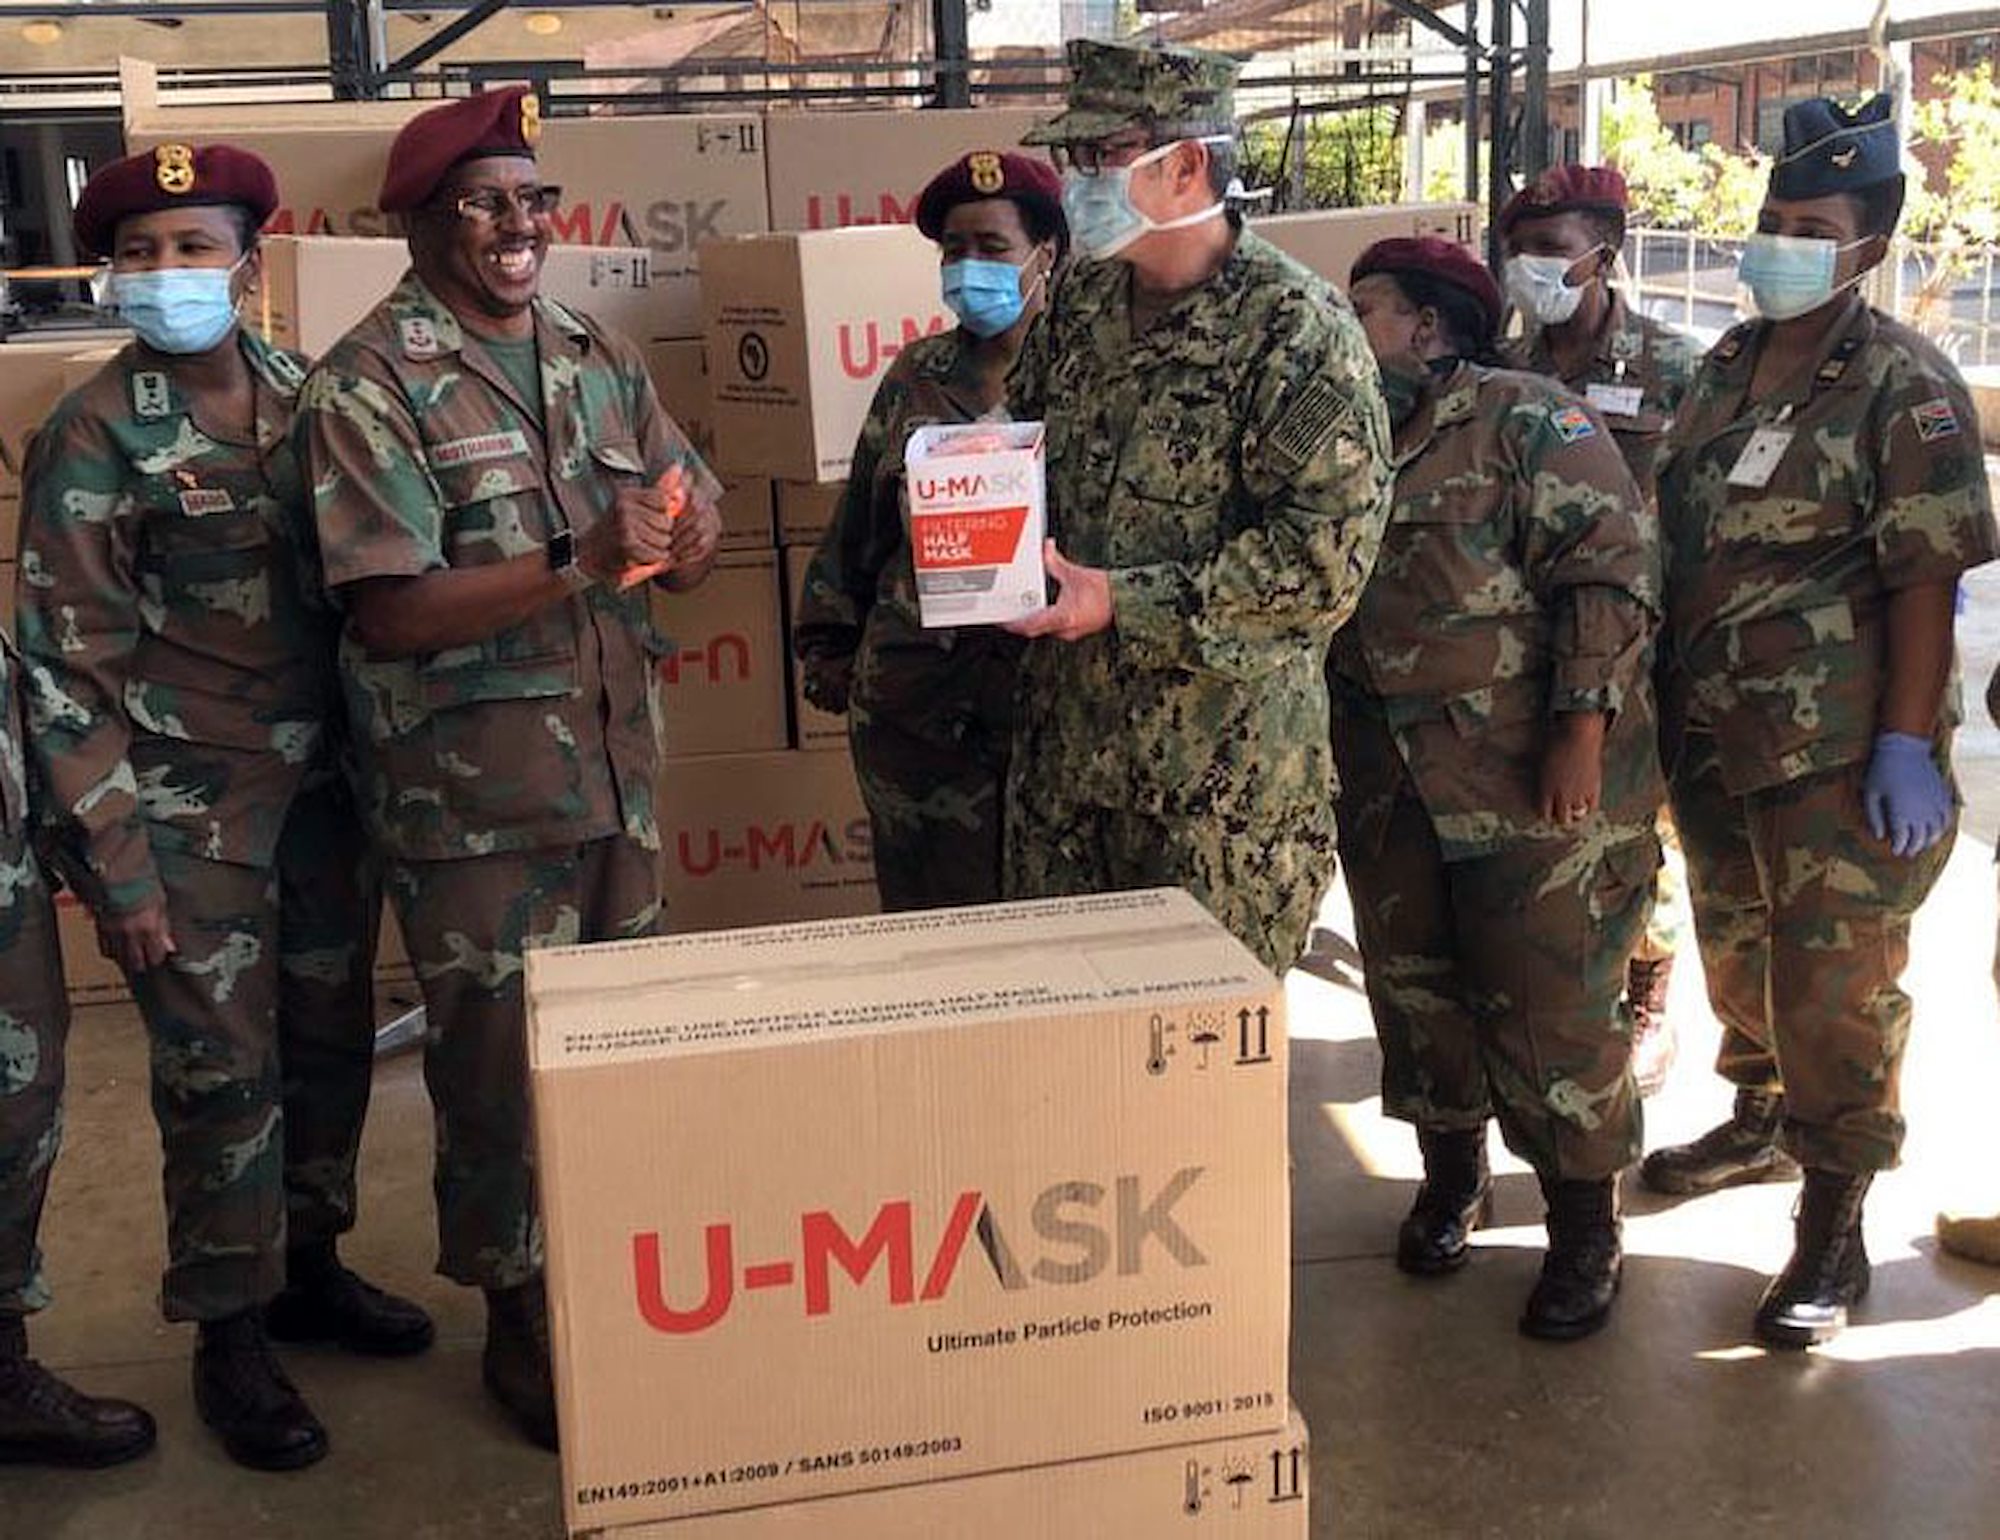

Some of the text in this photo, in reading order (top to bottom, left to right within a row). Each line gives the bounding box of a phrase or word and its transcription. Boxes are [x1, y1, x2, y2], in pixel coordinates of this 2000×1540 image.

[917, 472, 1028, 500] U-MASK
[633, 1166, 1208, 1334] U-MASK
[927, 1301, 1212, 1354] Ultimate Particle Protection
[1144, 1404, 1177, 1424] ISO
[799, 1452, 854, 1473] SANS
